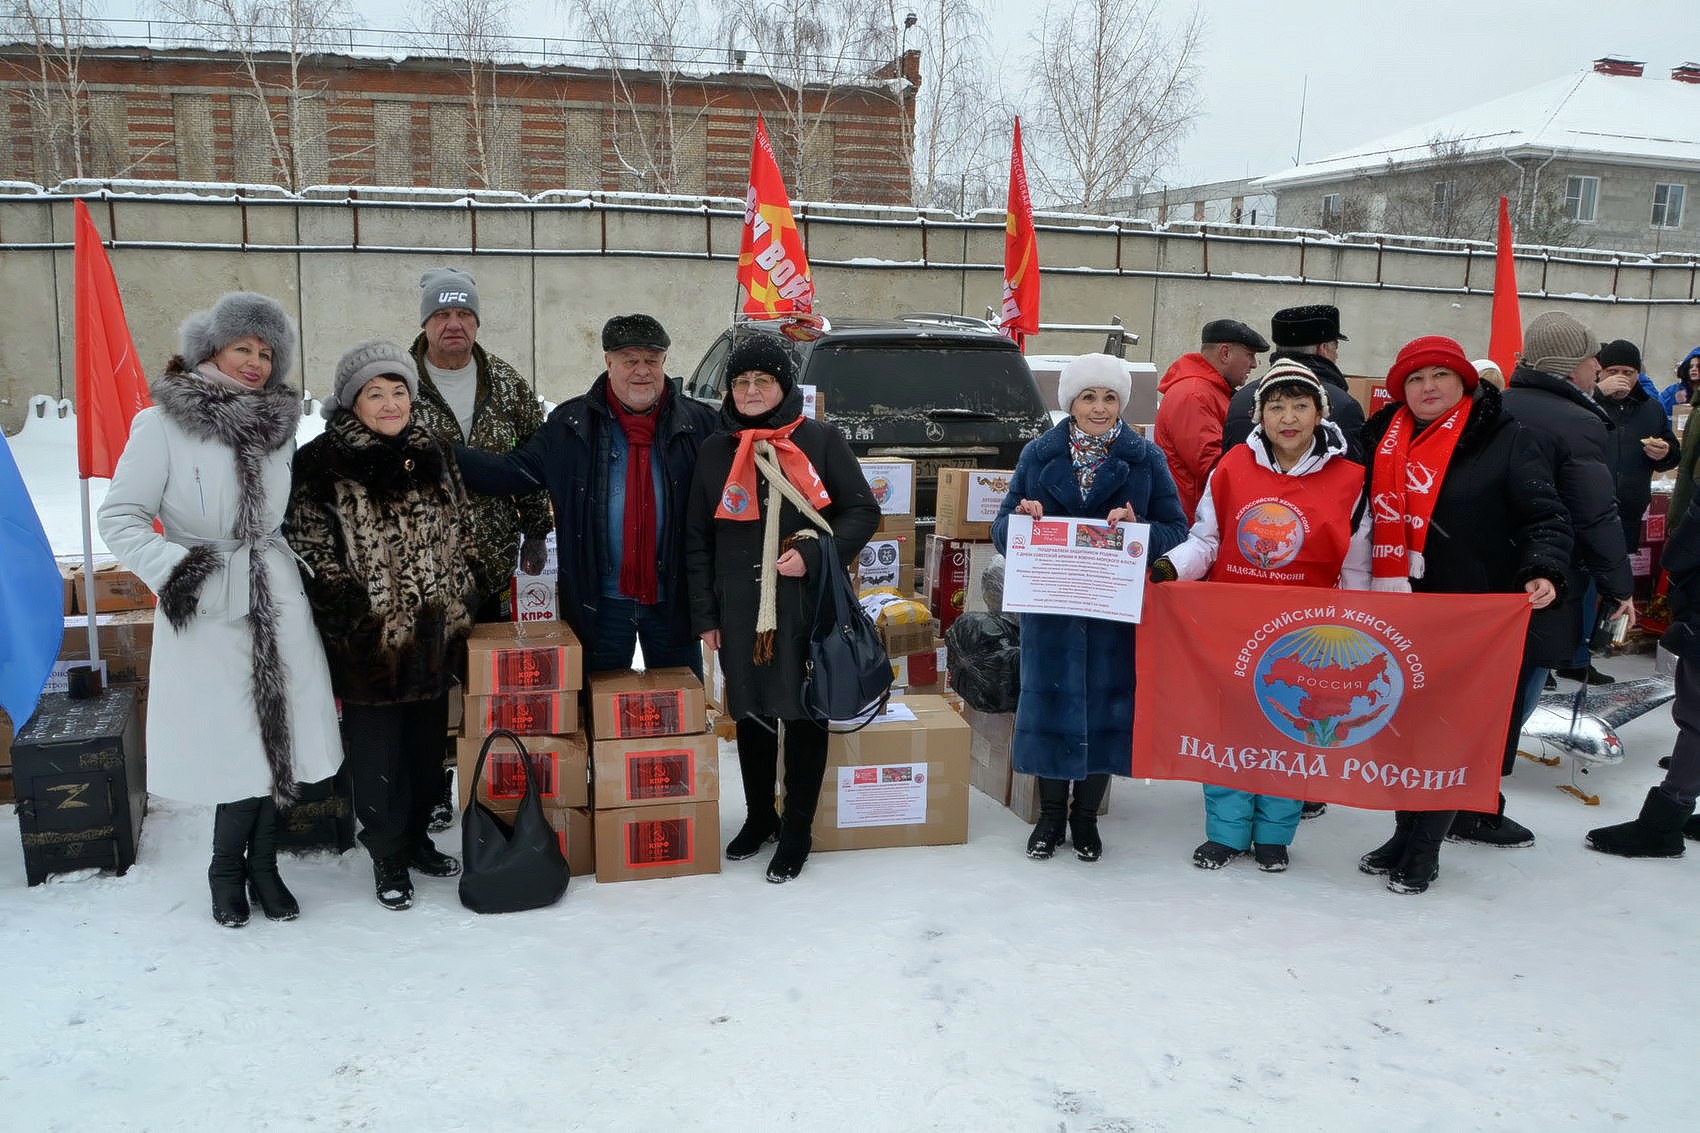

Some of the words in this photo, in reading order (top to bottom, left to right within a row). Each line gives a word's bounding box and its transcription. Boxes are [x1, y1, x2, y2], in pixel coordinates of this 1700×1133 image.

[438, 291, 468, 303] UFC
[1373, 388, 1392, 398] ЛЮ
[1235, 497, 1279, 520] ВСЕРОССИЙСКИЙ
[1279, 499, 1304, 517] ЖЕНСКИЙ
[1300, 515, 1311, 533] СОЮЗ
[1226, 563, 1268, 578] НАДЕЖДА
[1269, 571, 1305, 580] РОССИИ
[521, 610, 553, 621] КПРФ
[1233, 605, 1336, 678] ВСЕРОССИЙСКИЙ
[1341, 608, 1413, 652] ЖЕНСКИЙ
[1406, 653, 1425, 690] СОЮЗ
[1297, 676, 1363, 690] РОССИЯ
[1178, 735, 1329, 779] НАДЕЖДА
[1340, 757, 1469, 791] РОССИИ
[46, 782, 91, 810] Z
